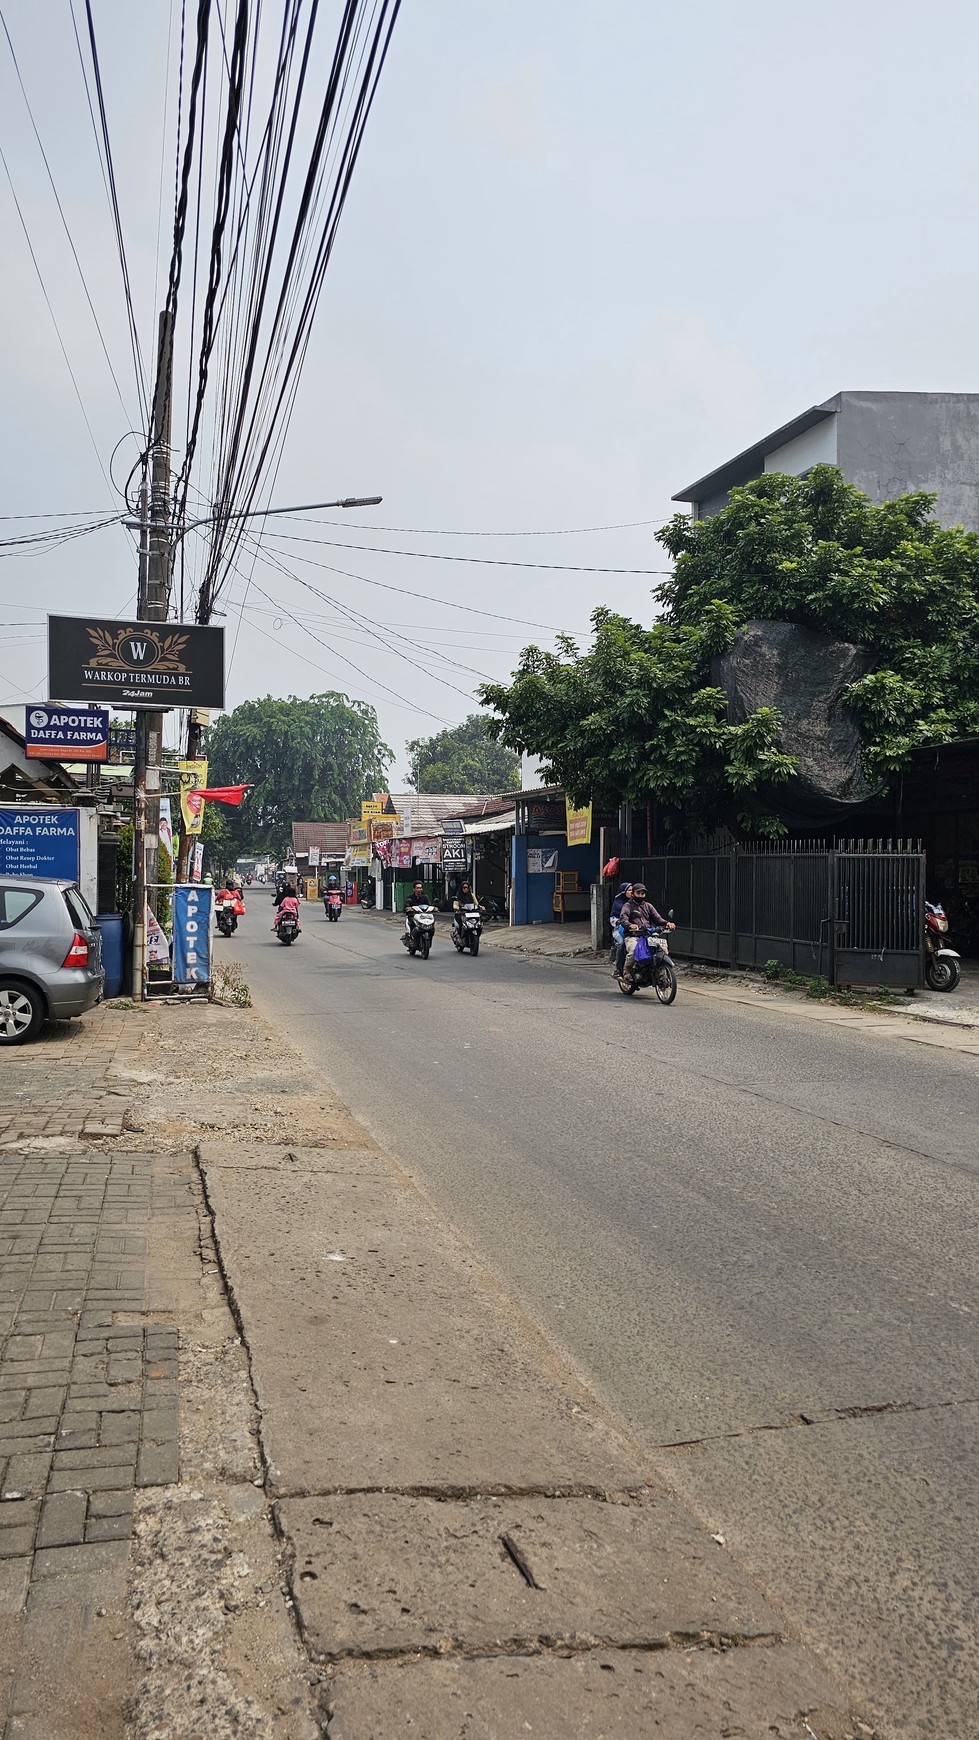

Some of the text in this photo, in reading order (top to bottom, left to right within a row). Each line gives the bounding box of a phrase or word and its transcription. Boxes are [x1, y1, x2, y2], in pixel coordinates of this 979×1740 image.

[129, 641, 148, 660] W
[84, 670, 191, 685] WARKOP TERMUDA BR
[122, 689, 153, 698] 24Jam
[49, 714, 103, 728] APOTEK
[30, 729, 104, 741] DAFFA FARMA
[14, 815, 58, 823] APOTEK
[36, 827, 75, 836] FARMA
[443, 849, 464, 858] AKI
[185, 890, 200, 980] APOTEK
